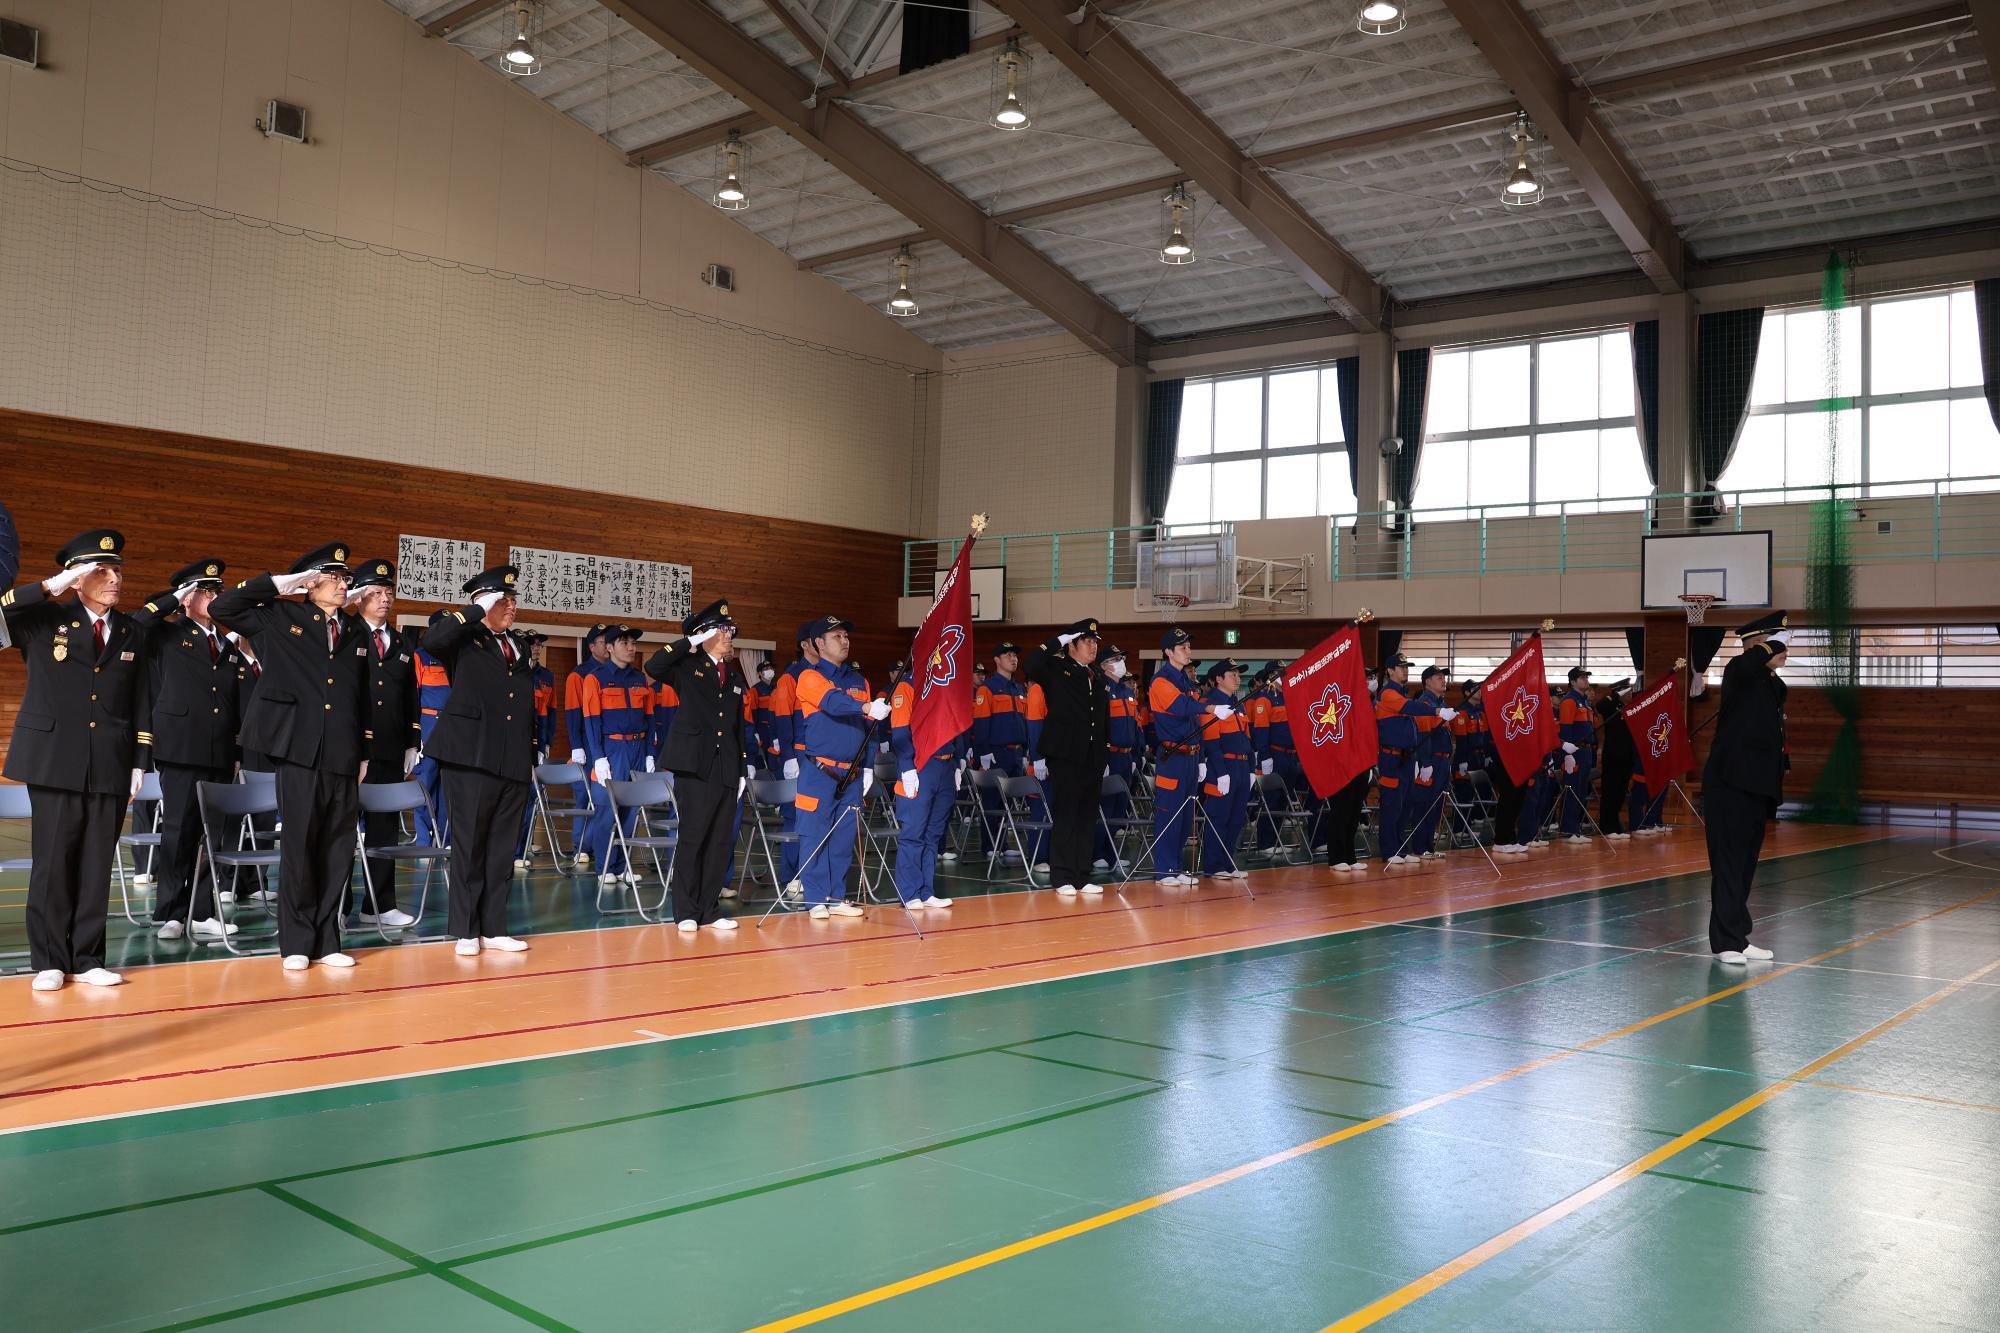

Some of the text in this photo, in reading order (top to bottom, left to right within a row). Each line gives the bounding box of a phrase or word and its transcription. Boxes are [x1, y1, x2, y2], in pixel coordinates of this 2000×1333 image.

[412, 541, 427, 600] 一戦必勝
[428, 540, 441, 597] 勇猛精進
[441, 539, 455, 602] 有言実行
[550, 553, 560, 610] リバウンド
[561, 558, 573, 611] 一生懸命
[574, 557, 587, 610] 一致団結
[585, 556, 598, 608] 日進月歩
[647, 562, 658, 618] 継続は力なり
[671, 566, 681, 617] 毎日練習
